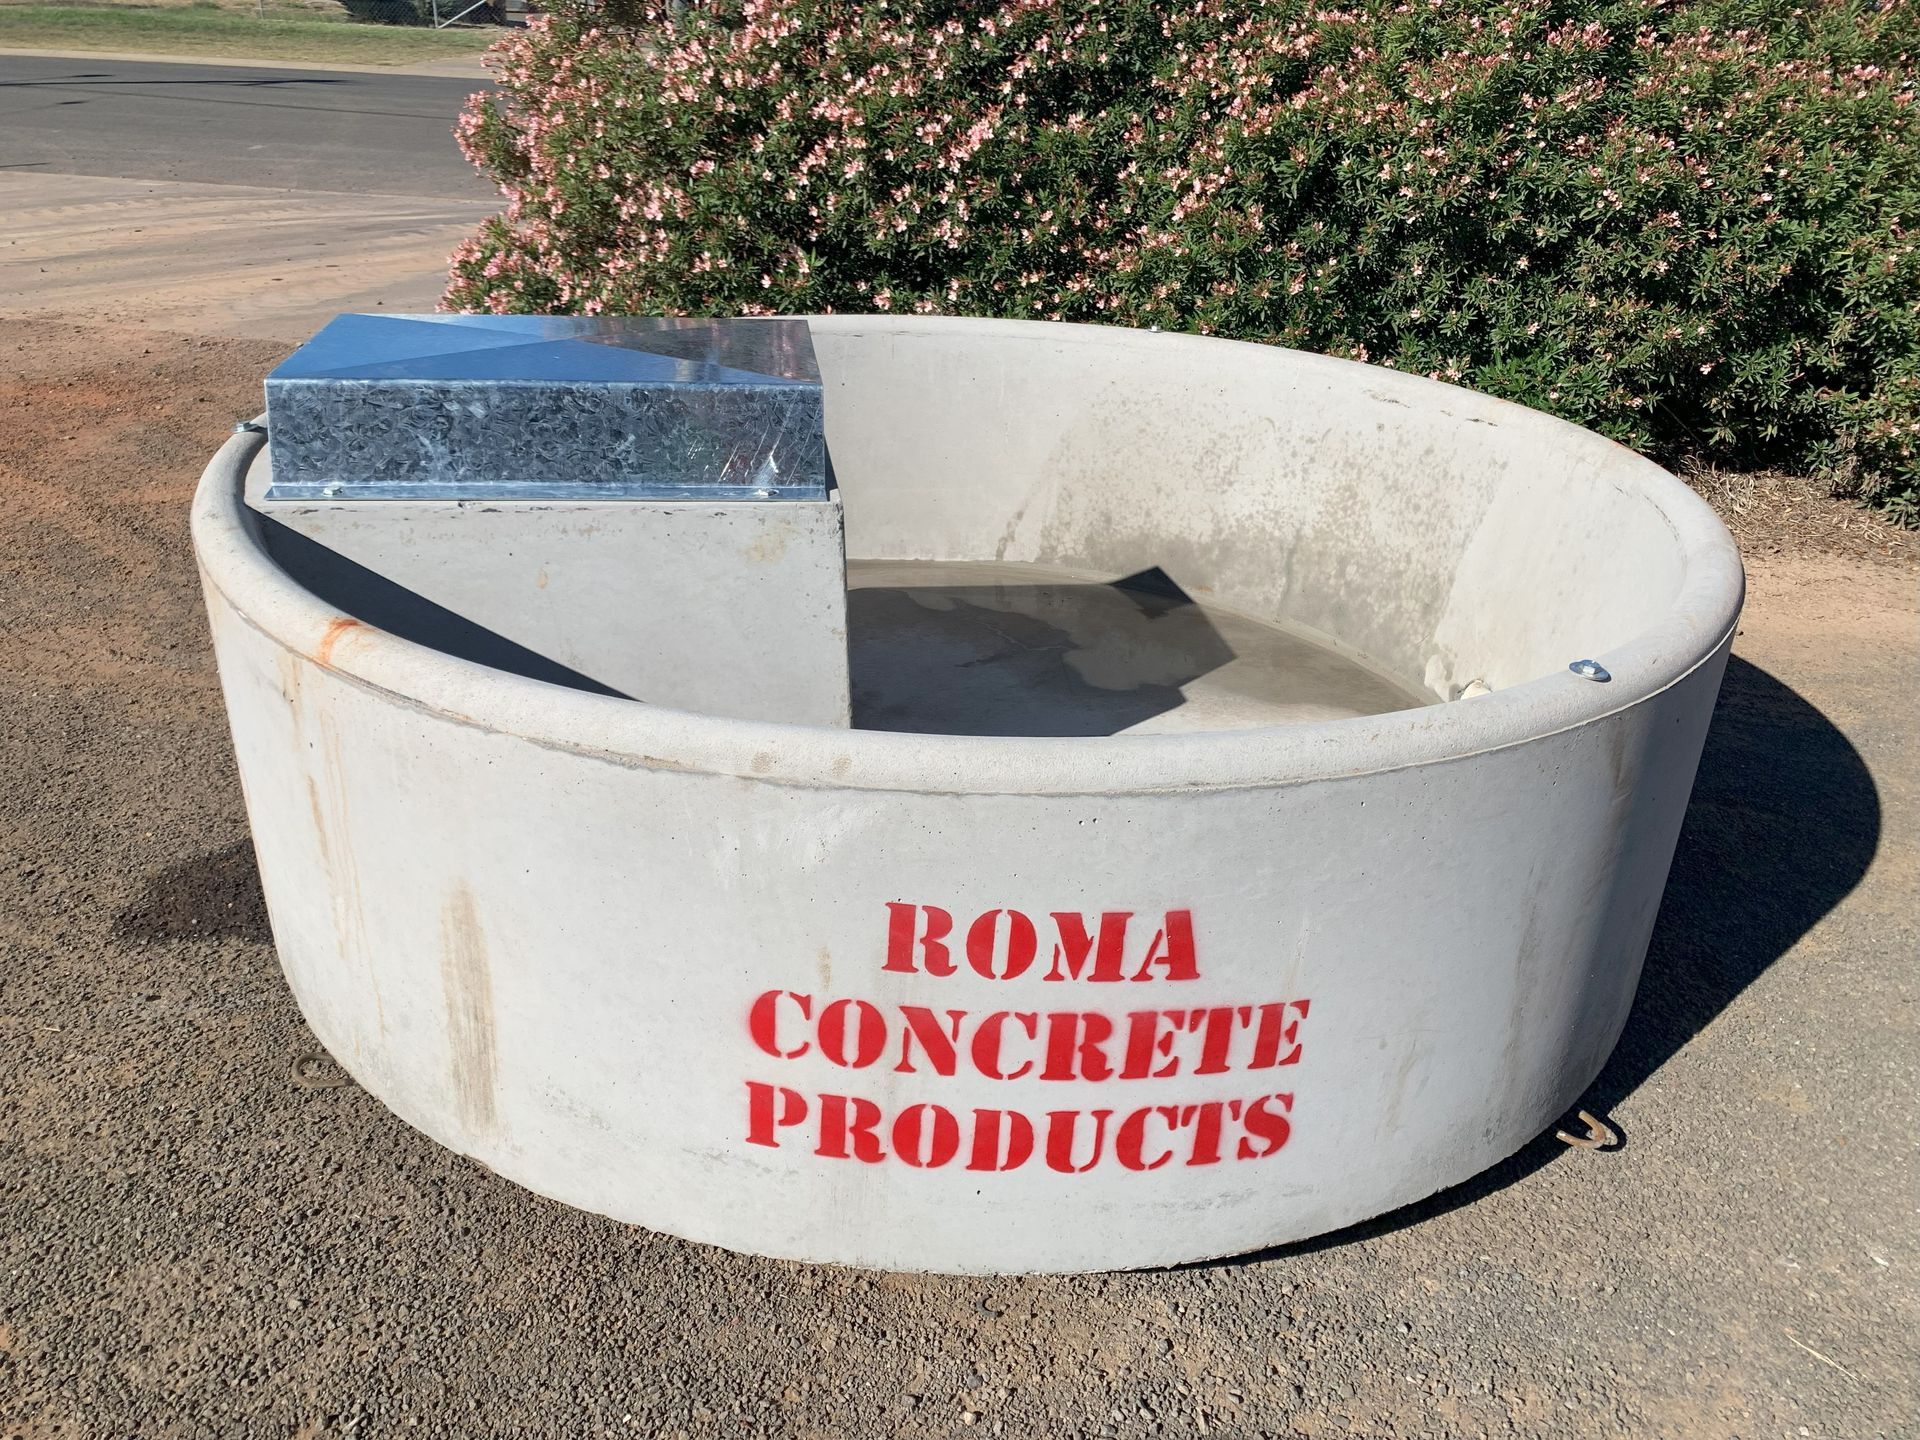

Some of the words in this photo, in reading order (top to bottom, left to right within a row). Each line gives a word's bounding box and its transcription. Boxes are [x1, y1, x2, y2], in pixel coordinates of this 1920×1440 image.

[882, 901, 1201, 983] ROMA
[748, 989, 1312, 1083] CONCRETE
[744, 1080, 1295, 1174] PRODUCTS
